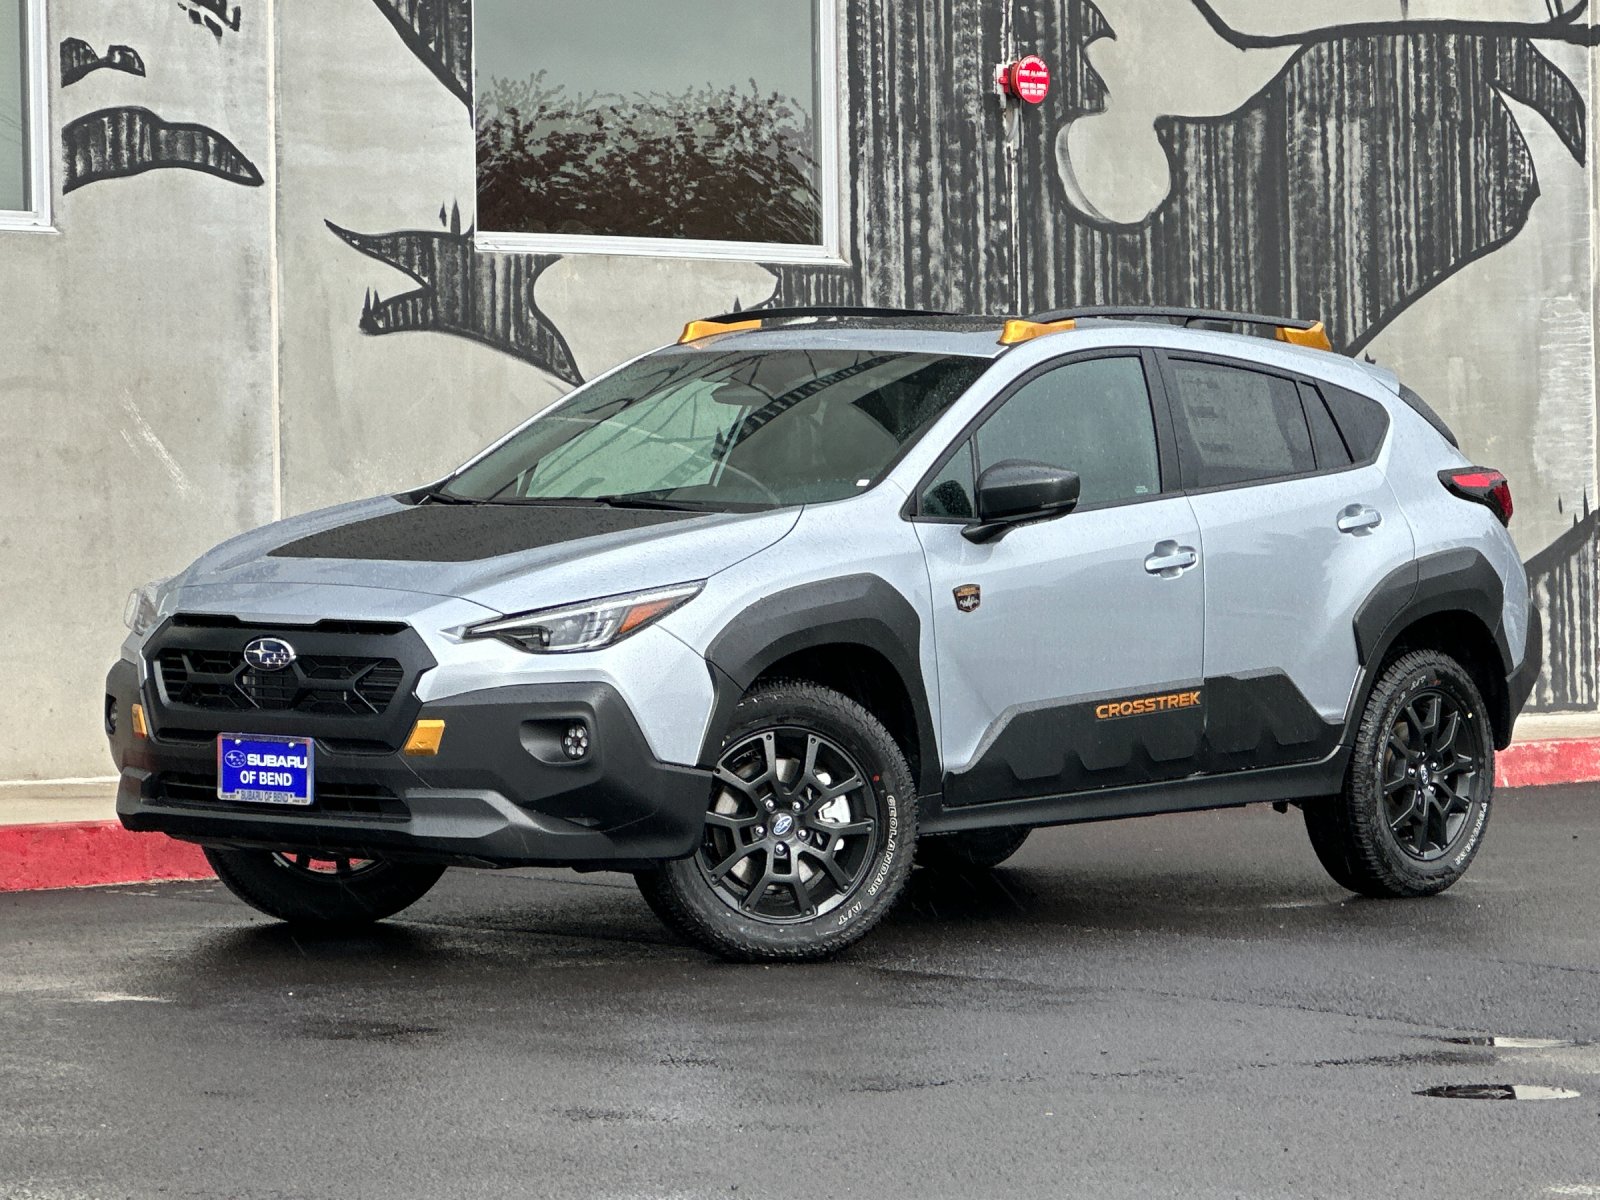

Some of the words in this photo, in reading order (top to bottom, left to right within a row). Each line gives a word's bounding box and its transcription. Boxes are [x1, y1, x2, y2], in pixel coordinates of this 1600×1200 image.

[1095, 690, 1201, 719] CROSSTREK
[247, 754, 308, 769] SUBARU
[240, 770, 256, 784] OF
[259, 771, 292, 787] BEND
[241, 790, 263, 800] SUBARU
[264, 791, 272, 800] OF
[273, 792, 289, 802] BEND
[867, 795, 898, 896] GEOLANDAR
